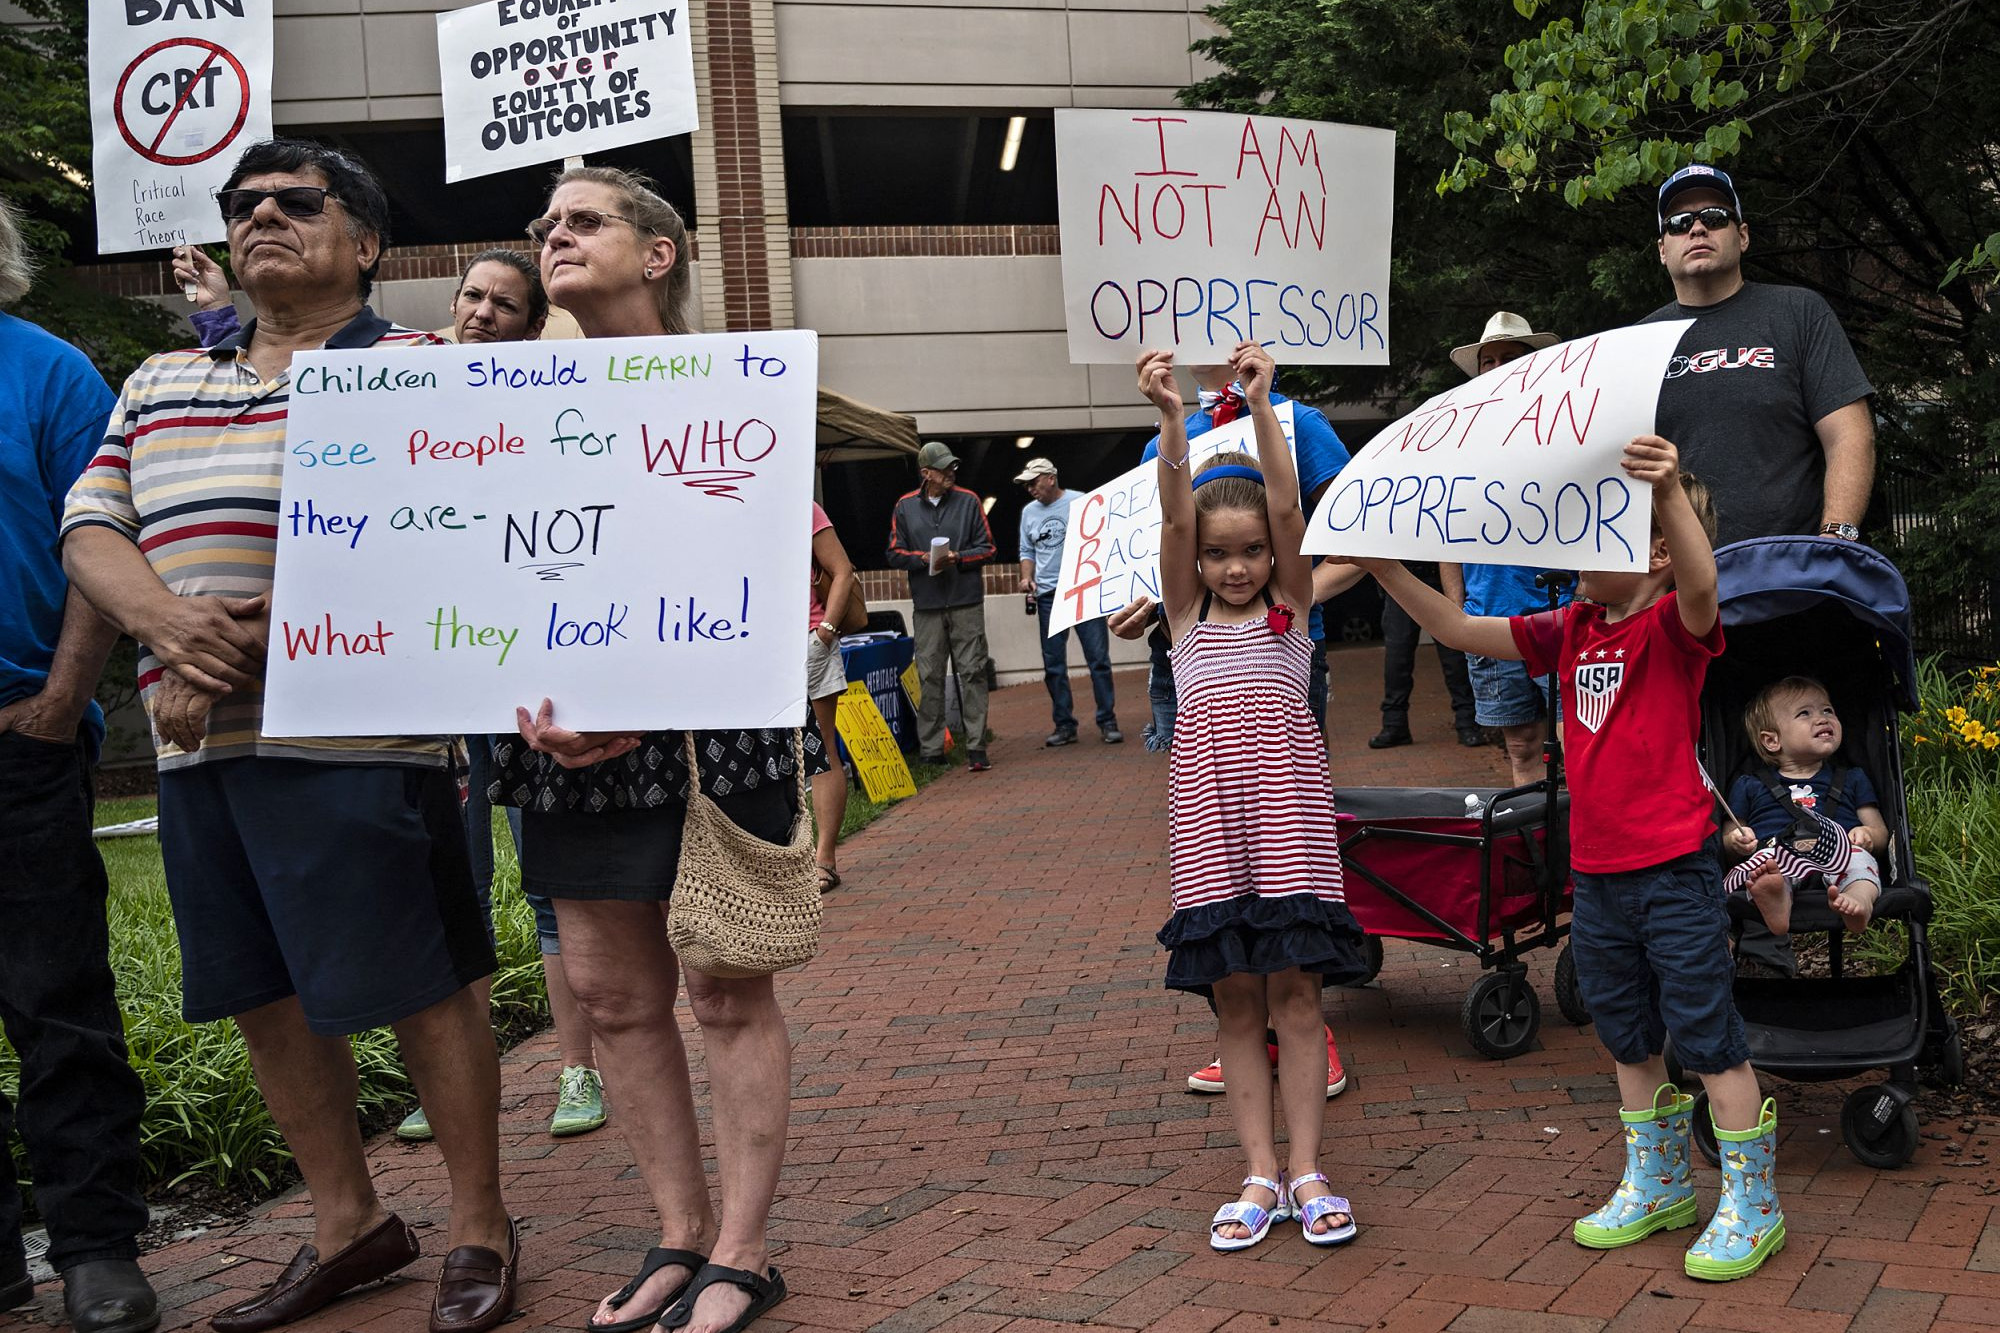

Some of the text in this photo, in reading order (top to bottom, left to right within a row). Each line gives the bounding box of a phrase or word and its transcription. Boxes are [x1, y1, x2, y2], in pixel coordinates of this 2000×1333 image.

[470, 8, 677, 80] OPPORTUNITY
[557, 12, 581, 30] OF
[141, 66, 222, 116] CRT
[492, 67, 640, 119] EQUITY OF
[523, 51, 619, 86] over
[481, 90, 651, 151] OUTCOMES
[1132, 117, 1327, 195] I AM
[133, 176, 185, 205] Critical
[136, 207, 166, 227] Race
[134, 227, 187, 246] Theory
[1100, 183, 1327, 256] NOT AN
[1091, 277, 1385, 350] OPPRESSOR
[296, 365, 437, 395] Children
[608, 354, 711, 382] LEARN
[735, 344, 786, 377] to
[1490, 337, 1600, 397] AM
[550, 408, 617, 456] for
[641, 418, 777, 473] WHO
[1372, 387, 1600, 459] NOT AN
[287, 499, 369, 549] they
[504, 505, 615, 563] NOT
[1328, 475, 1633, 563] OPPRESSOR
[426, 605, 518, 666] they
[658, 576, 750, 642] like!
[866, 667, 899, 693] HERITAGE
[1578, 666, 1620, 693] USA
[862, 765, 884, 796] NOT
